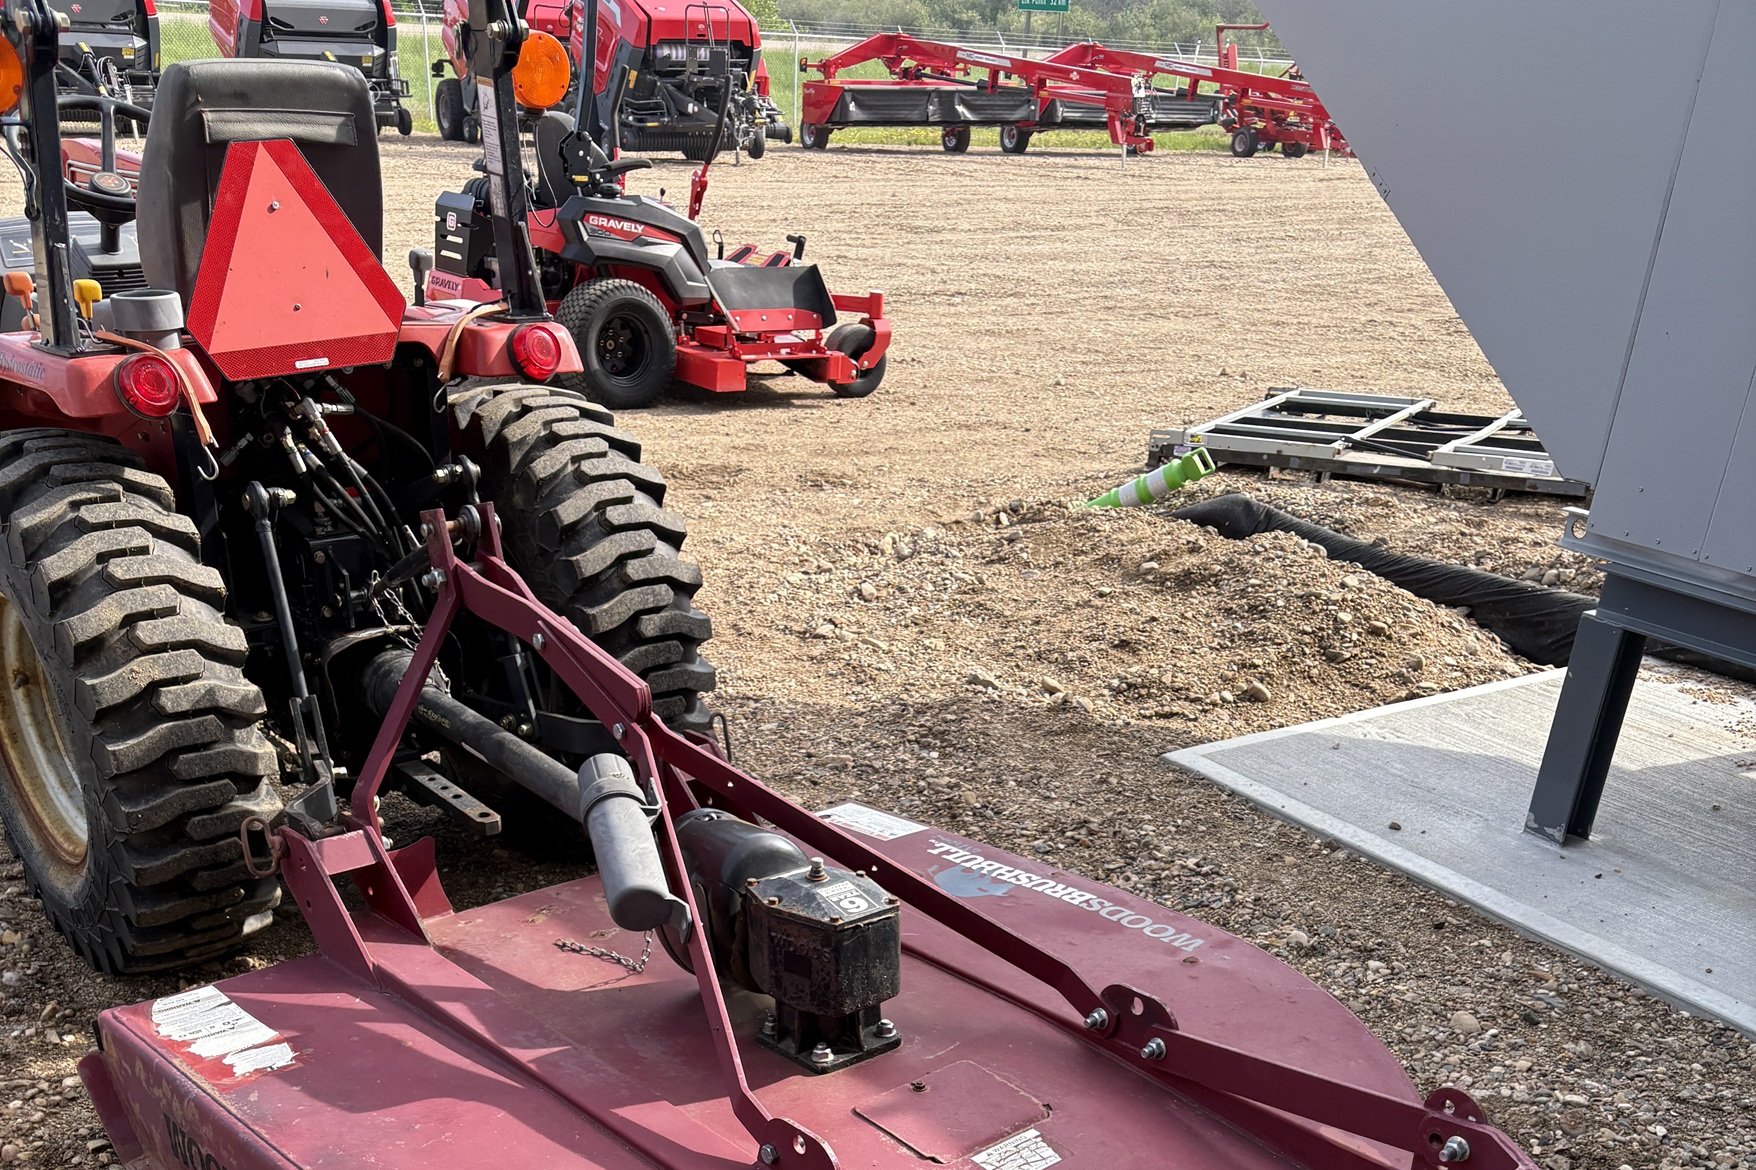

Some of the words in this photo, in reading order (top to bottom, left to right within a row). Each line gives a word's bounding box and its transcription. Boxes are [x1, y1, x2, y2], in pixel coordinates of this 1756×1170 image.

[589, 215, 645, 233] GRAVELY
[430, 275, 460, 291] GRAVELY
[840, 897, 869, 912] 6
